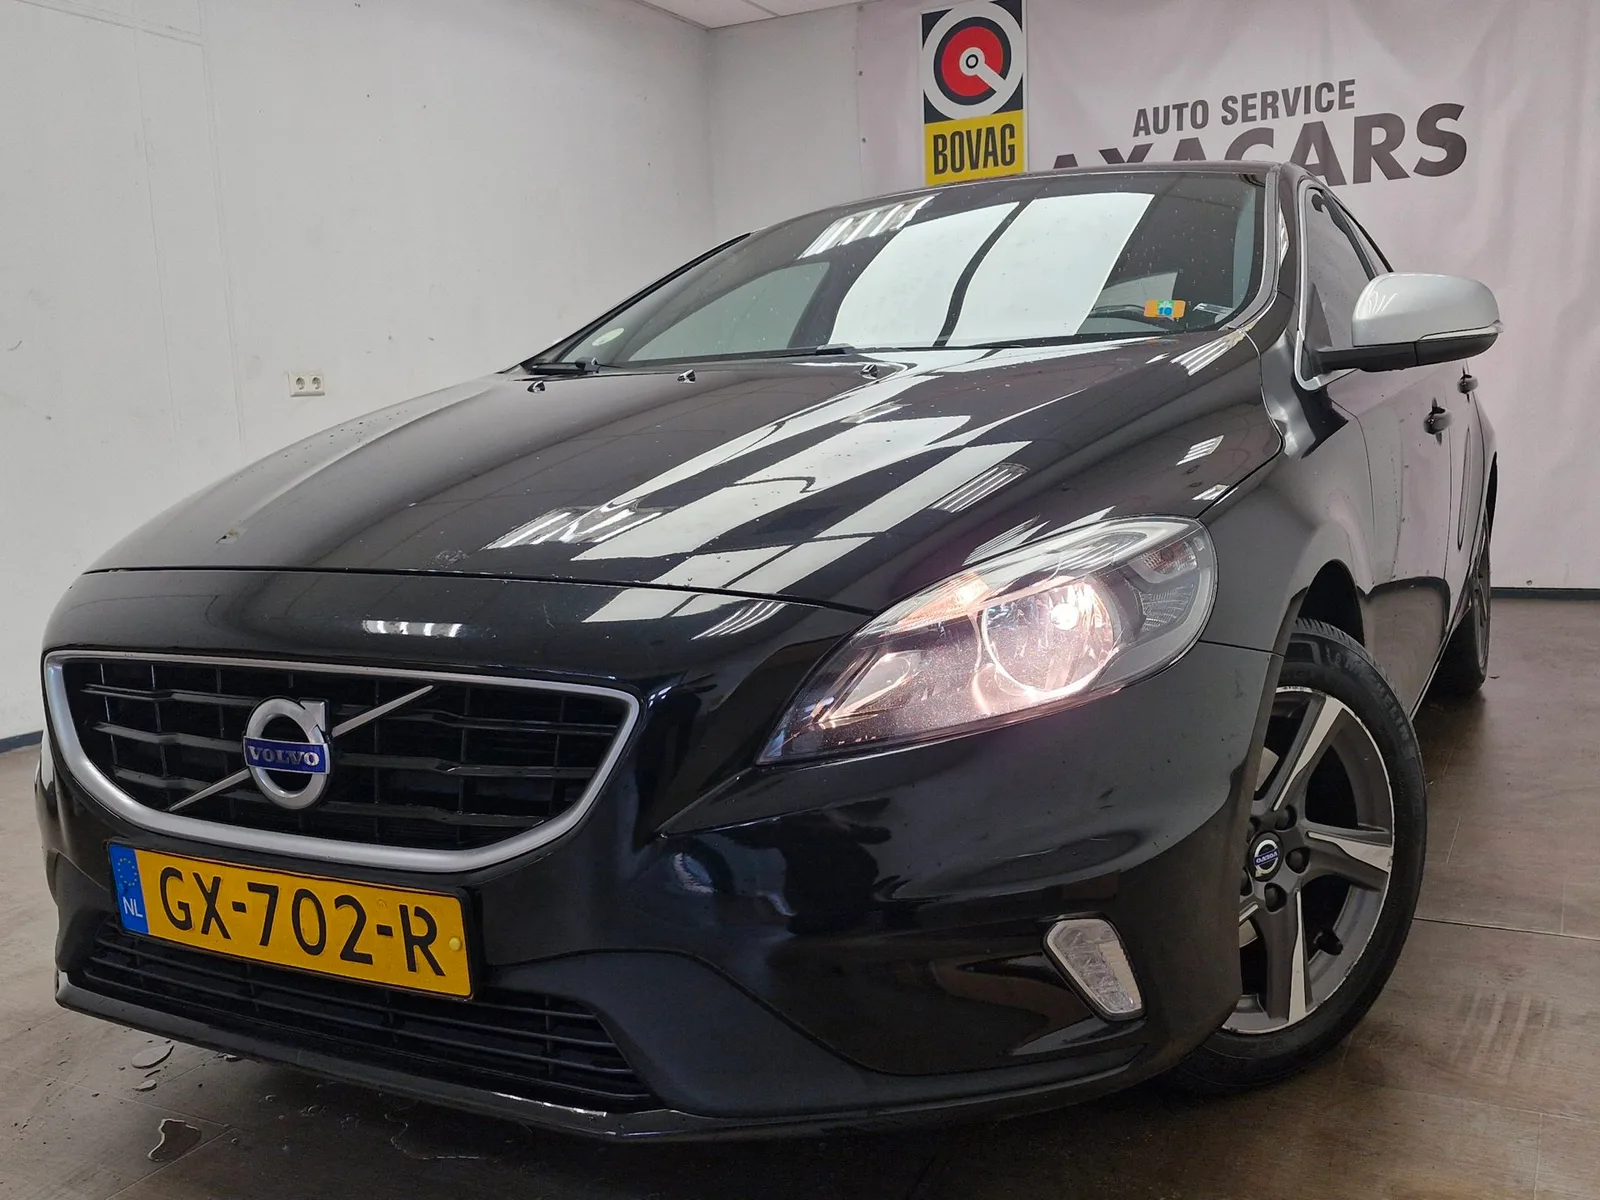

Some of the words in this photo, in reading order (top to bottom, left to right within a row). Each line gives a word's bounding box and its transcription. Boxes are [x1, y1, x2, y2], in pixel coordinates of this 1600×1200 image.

[1133, 100, 1209, 137] AUTO
[1221, 79, 1355, 126] SERVICE
[933, 123, 1015, 175] BOVAG
[248, 745, 320, 766] VOLVO
[122, 896, 143, 918] NL
[160, 866, 446, 977] GX-702-R
